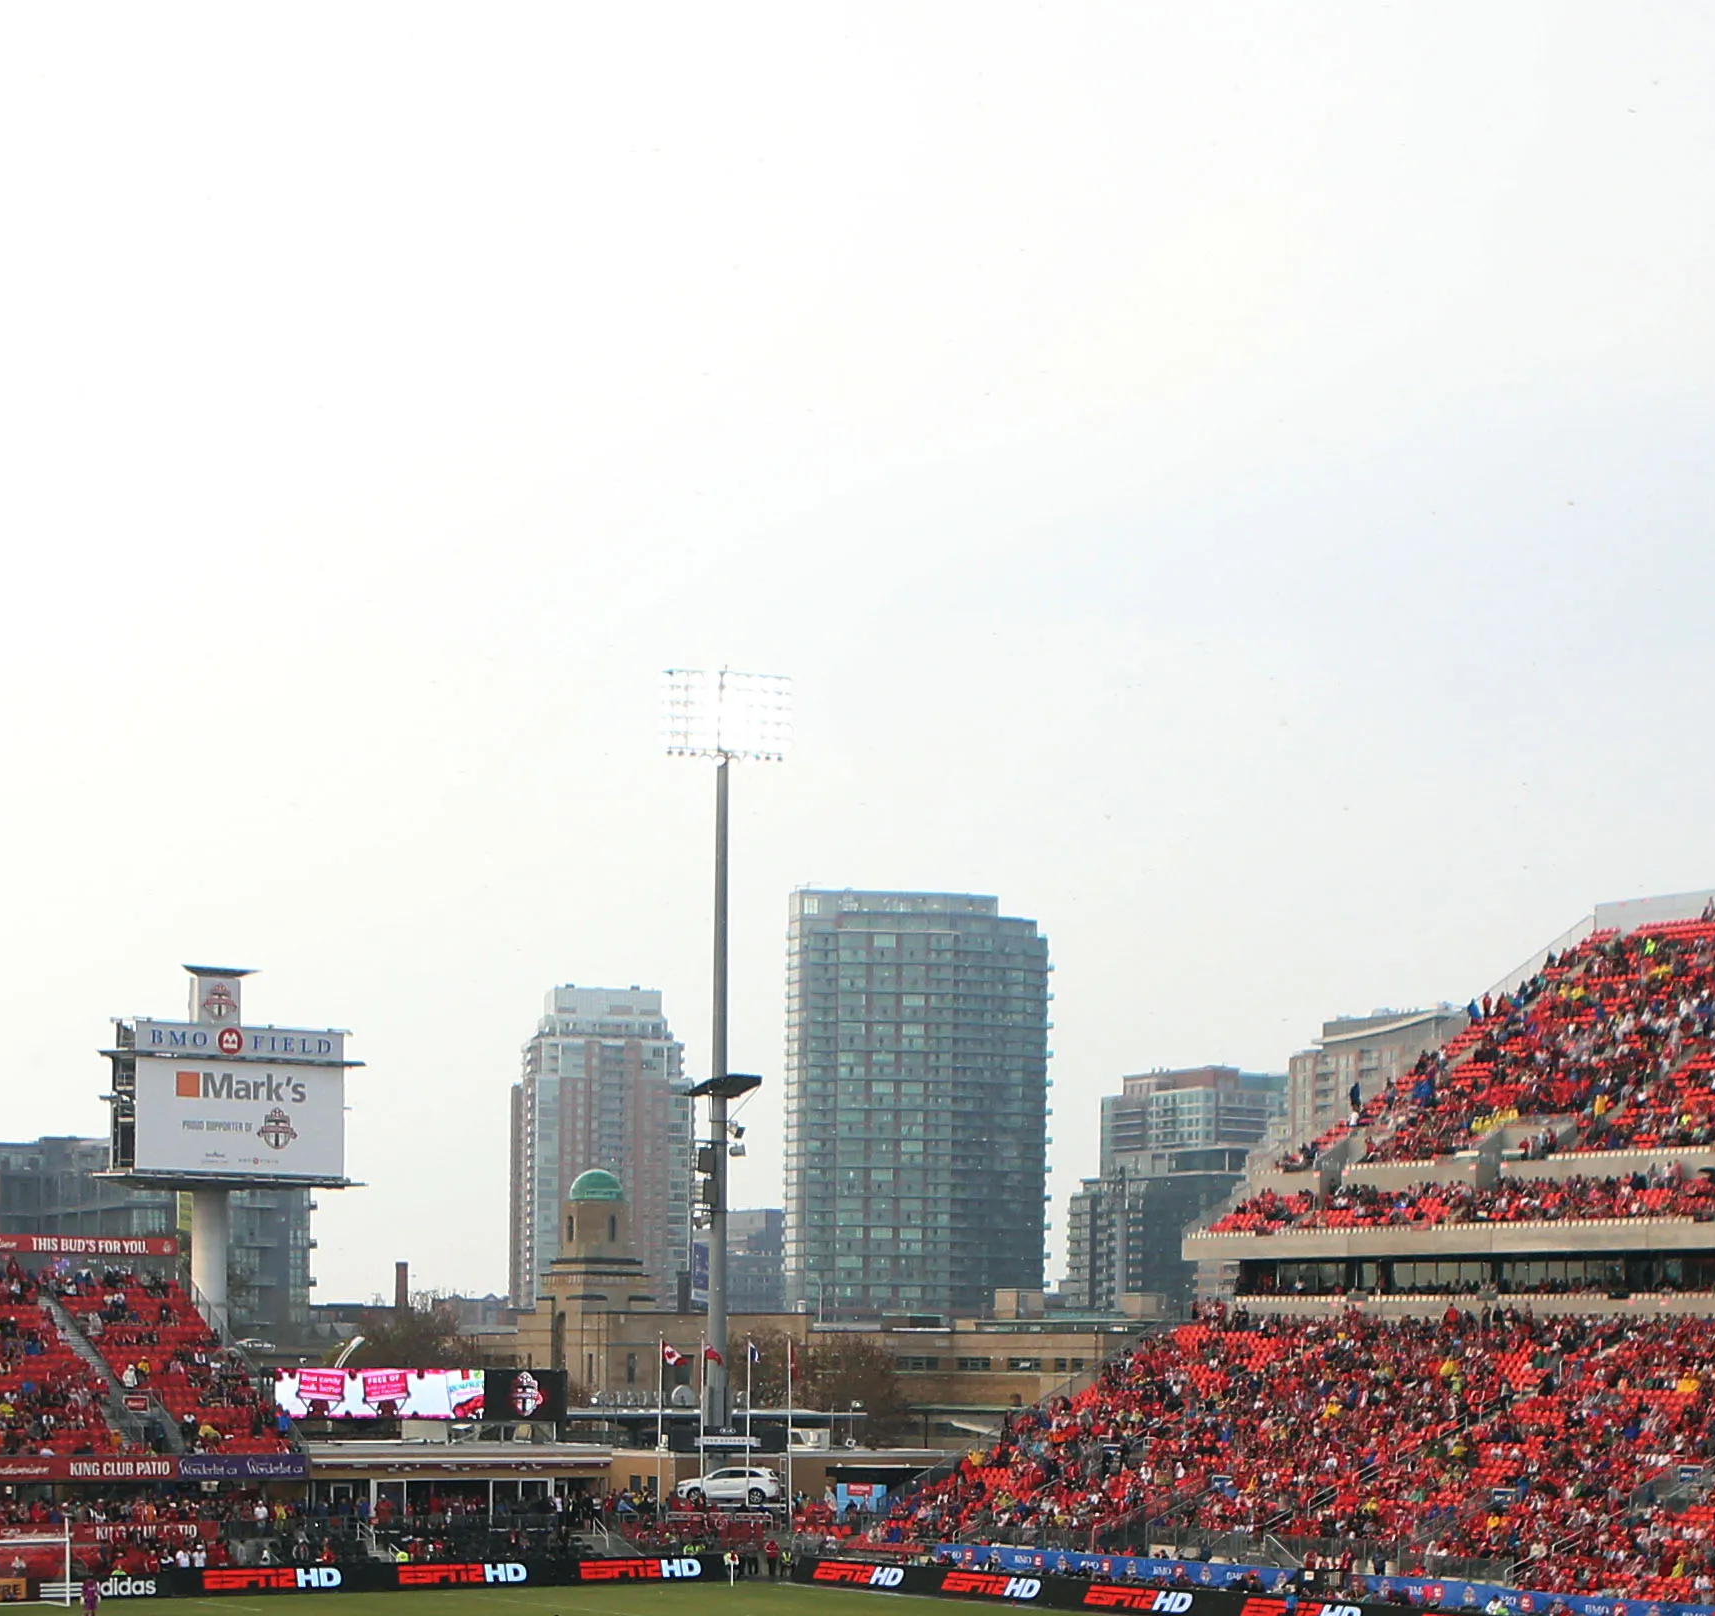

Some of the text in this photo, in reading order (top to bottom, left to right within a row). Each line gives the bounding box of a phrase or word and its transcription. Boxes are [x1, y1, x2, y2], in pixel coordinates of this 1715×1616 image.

[151, 1029, 333, 1055] BMO FIELD
[202, 1072, 307, 1103] Mark's
[31, 1237, 59, 1252] THIS
[60, 1239, 96, 1253] BUD'S
[98, 1240, 121, 1254] FOR
[69, 1462, 100, 1476] KING
[101, 1461, 134, 1476] CLUB
[136, 1460, 171, 1475] PATIO
[96, 1576, 157, 1597] didas
